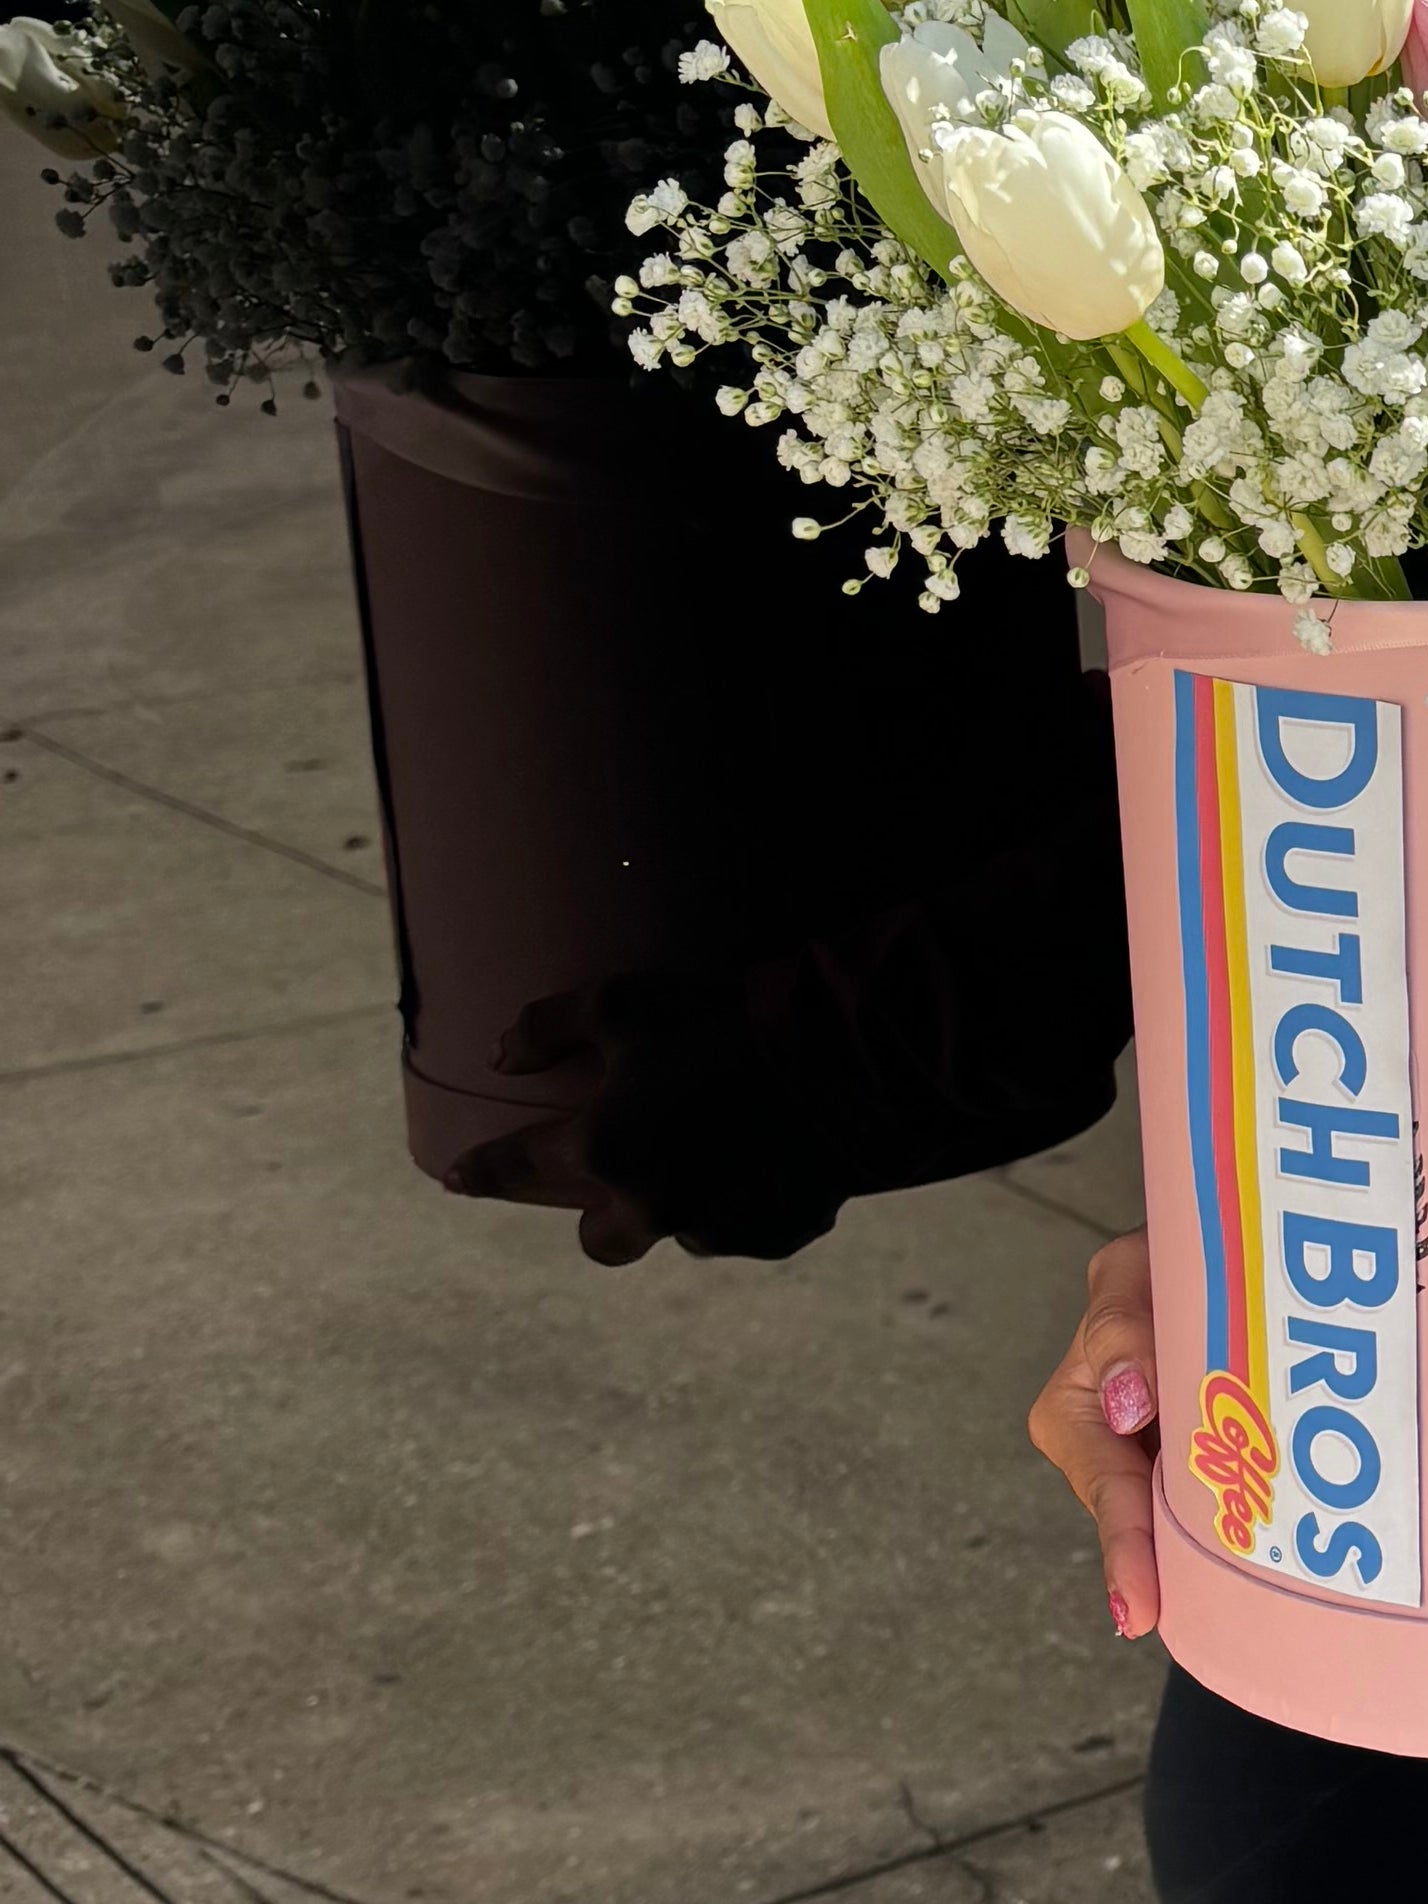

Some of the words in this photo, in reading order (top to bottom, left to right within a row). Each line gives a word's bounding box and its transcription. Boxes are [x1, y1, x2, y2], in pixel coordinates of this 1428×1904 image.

[1257, 684, 1399, 1185] DUTCH
[1193, 1375, 1276, 1549] Coffee
[1281, 1211, 1401, 1588] BROS
